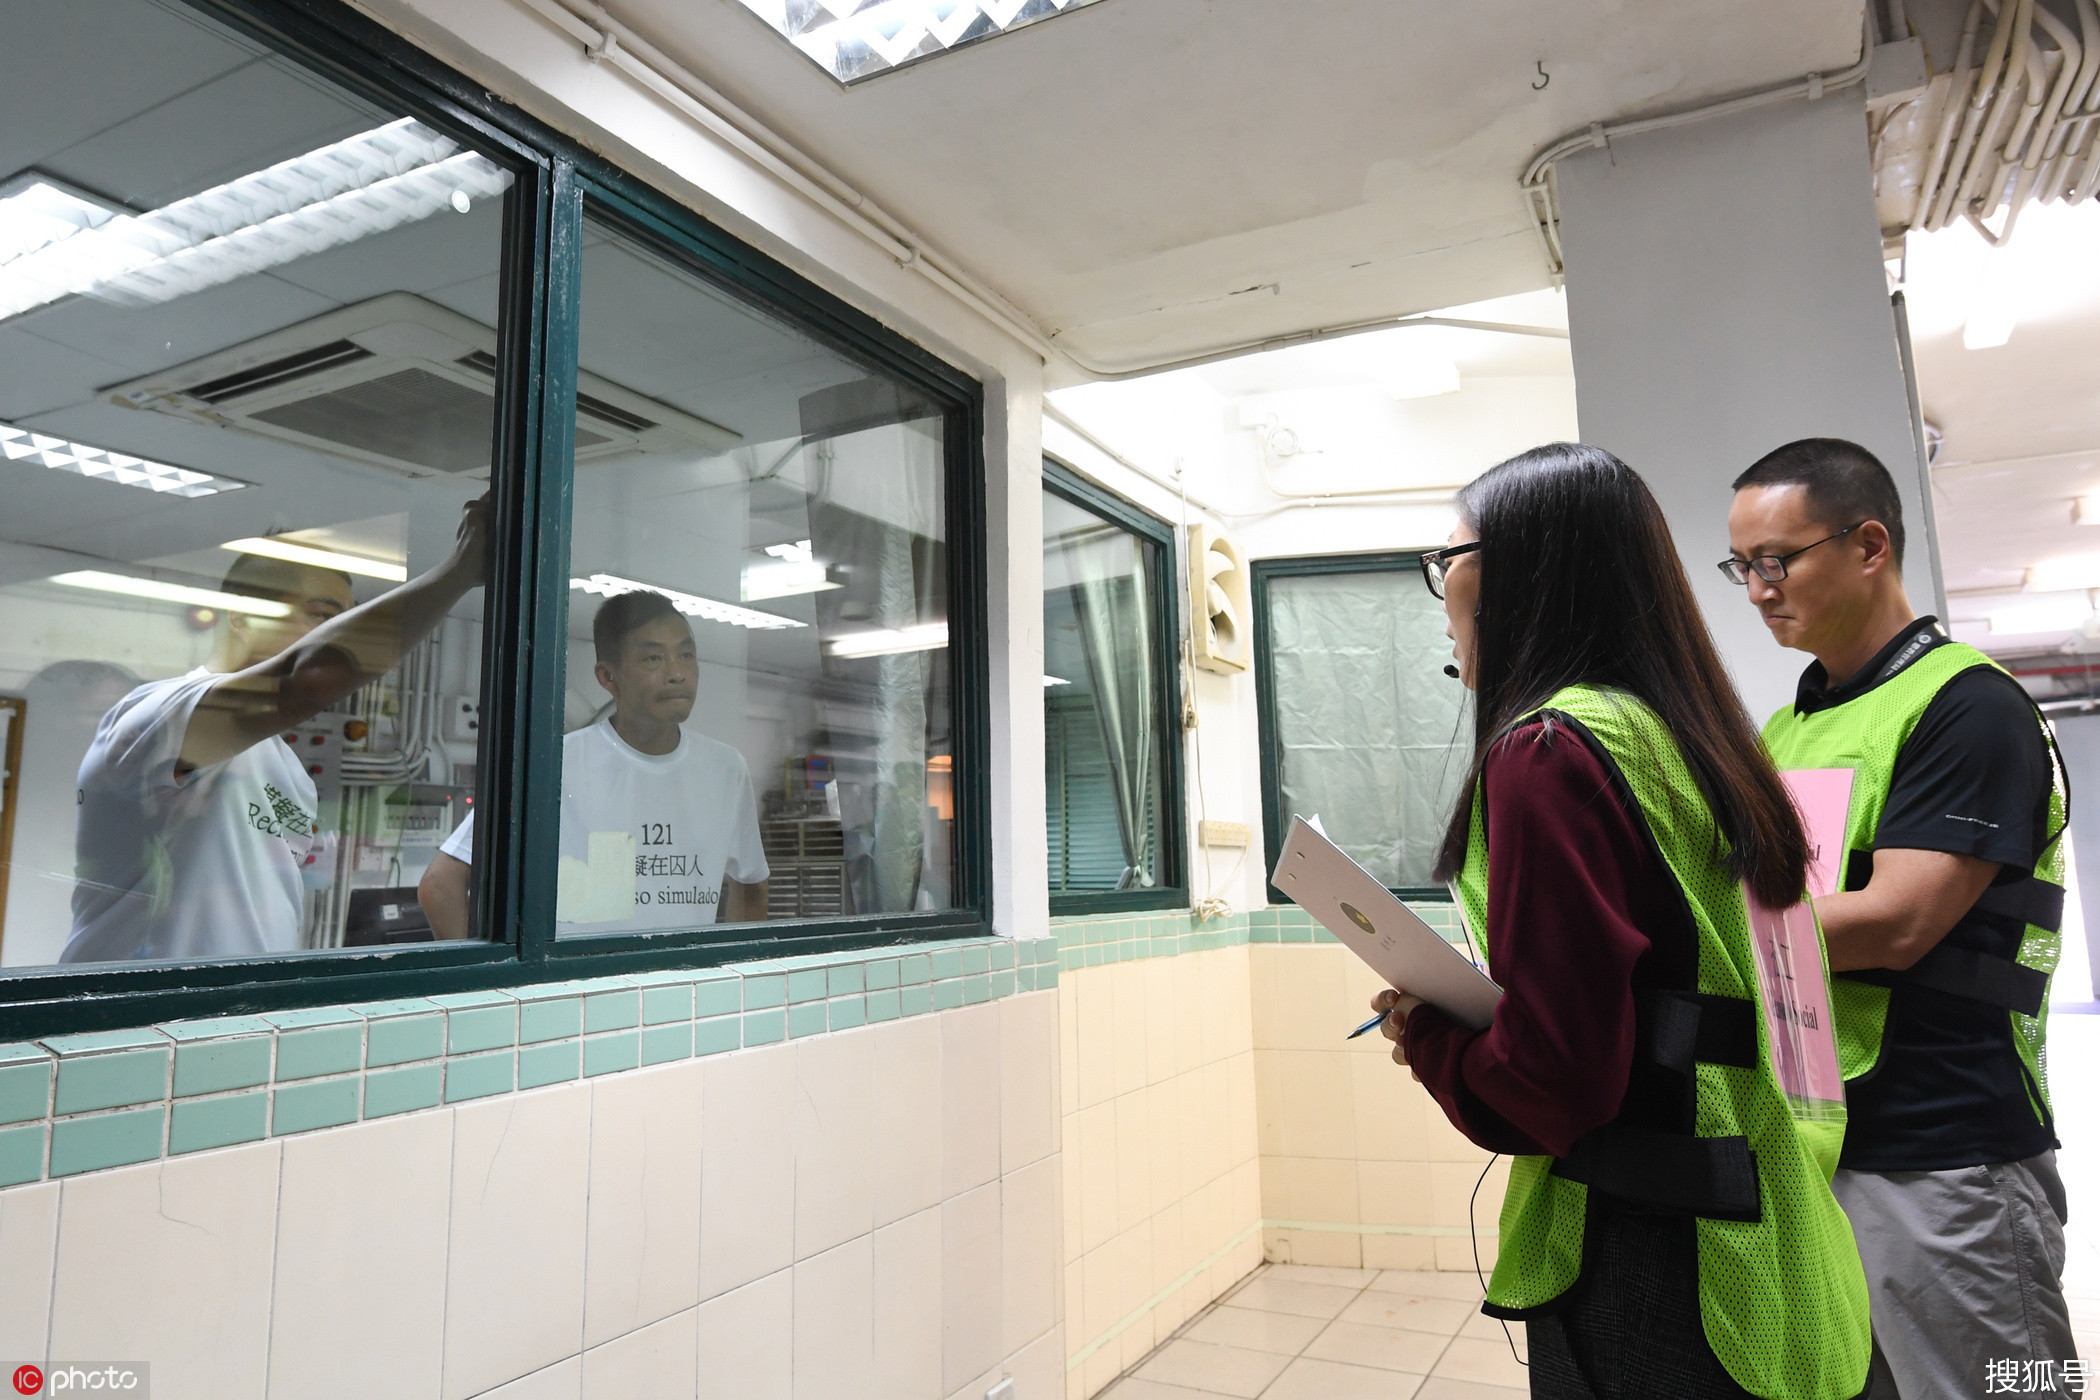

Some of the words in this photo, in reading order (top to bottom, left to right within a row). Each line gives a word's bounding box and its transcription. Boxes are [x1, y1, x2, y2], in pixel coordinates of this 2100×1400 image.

[248, 802, 282, 838] Rec
[641, 823, 673, 846] 121
[657, 885, 719, 905] simulado
